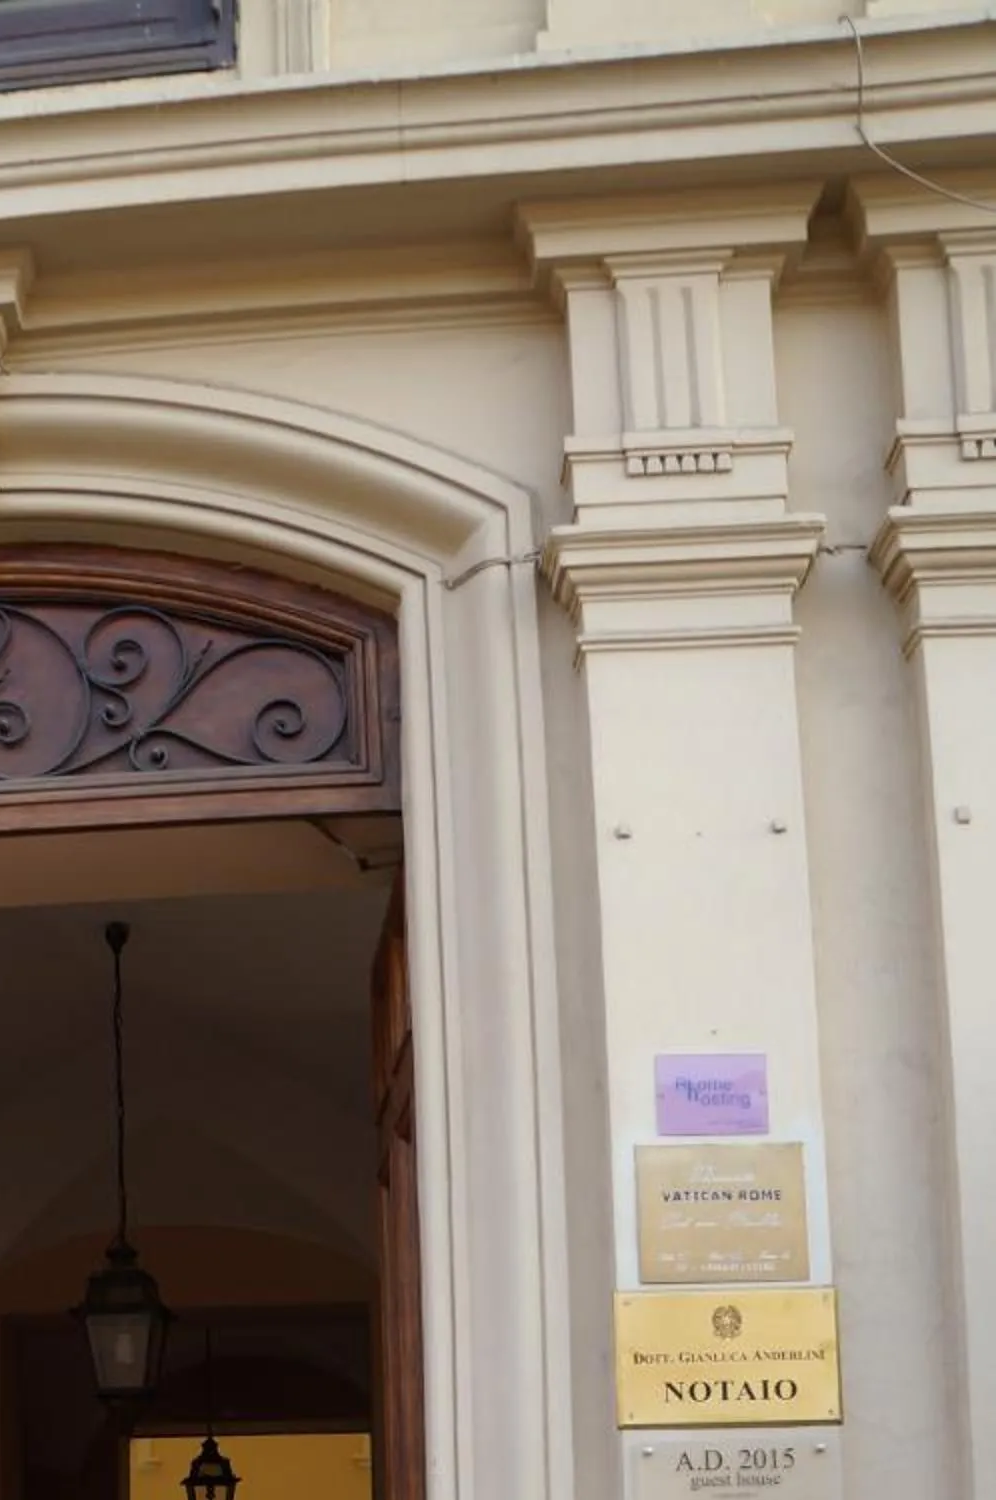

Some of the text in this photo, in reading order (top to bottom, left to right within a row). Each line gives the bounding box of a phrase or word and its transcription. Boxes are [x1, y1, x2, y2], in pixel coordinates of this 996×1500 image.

[662, 1189, 781, 1202] VATICAN ROME
[679, 1351, 748, 1363] GIANLUCA
[754, 1349, 825, 1361] ANDERLINI
[664, 1379, 798, 1403] NOTAIO
[676, 1447, 795, 1471] A.D. 2015
[690, 1472, 781, 1491] guest house
